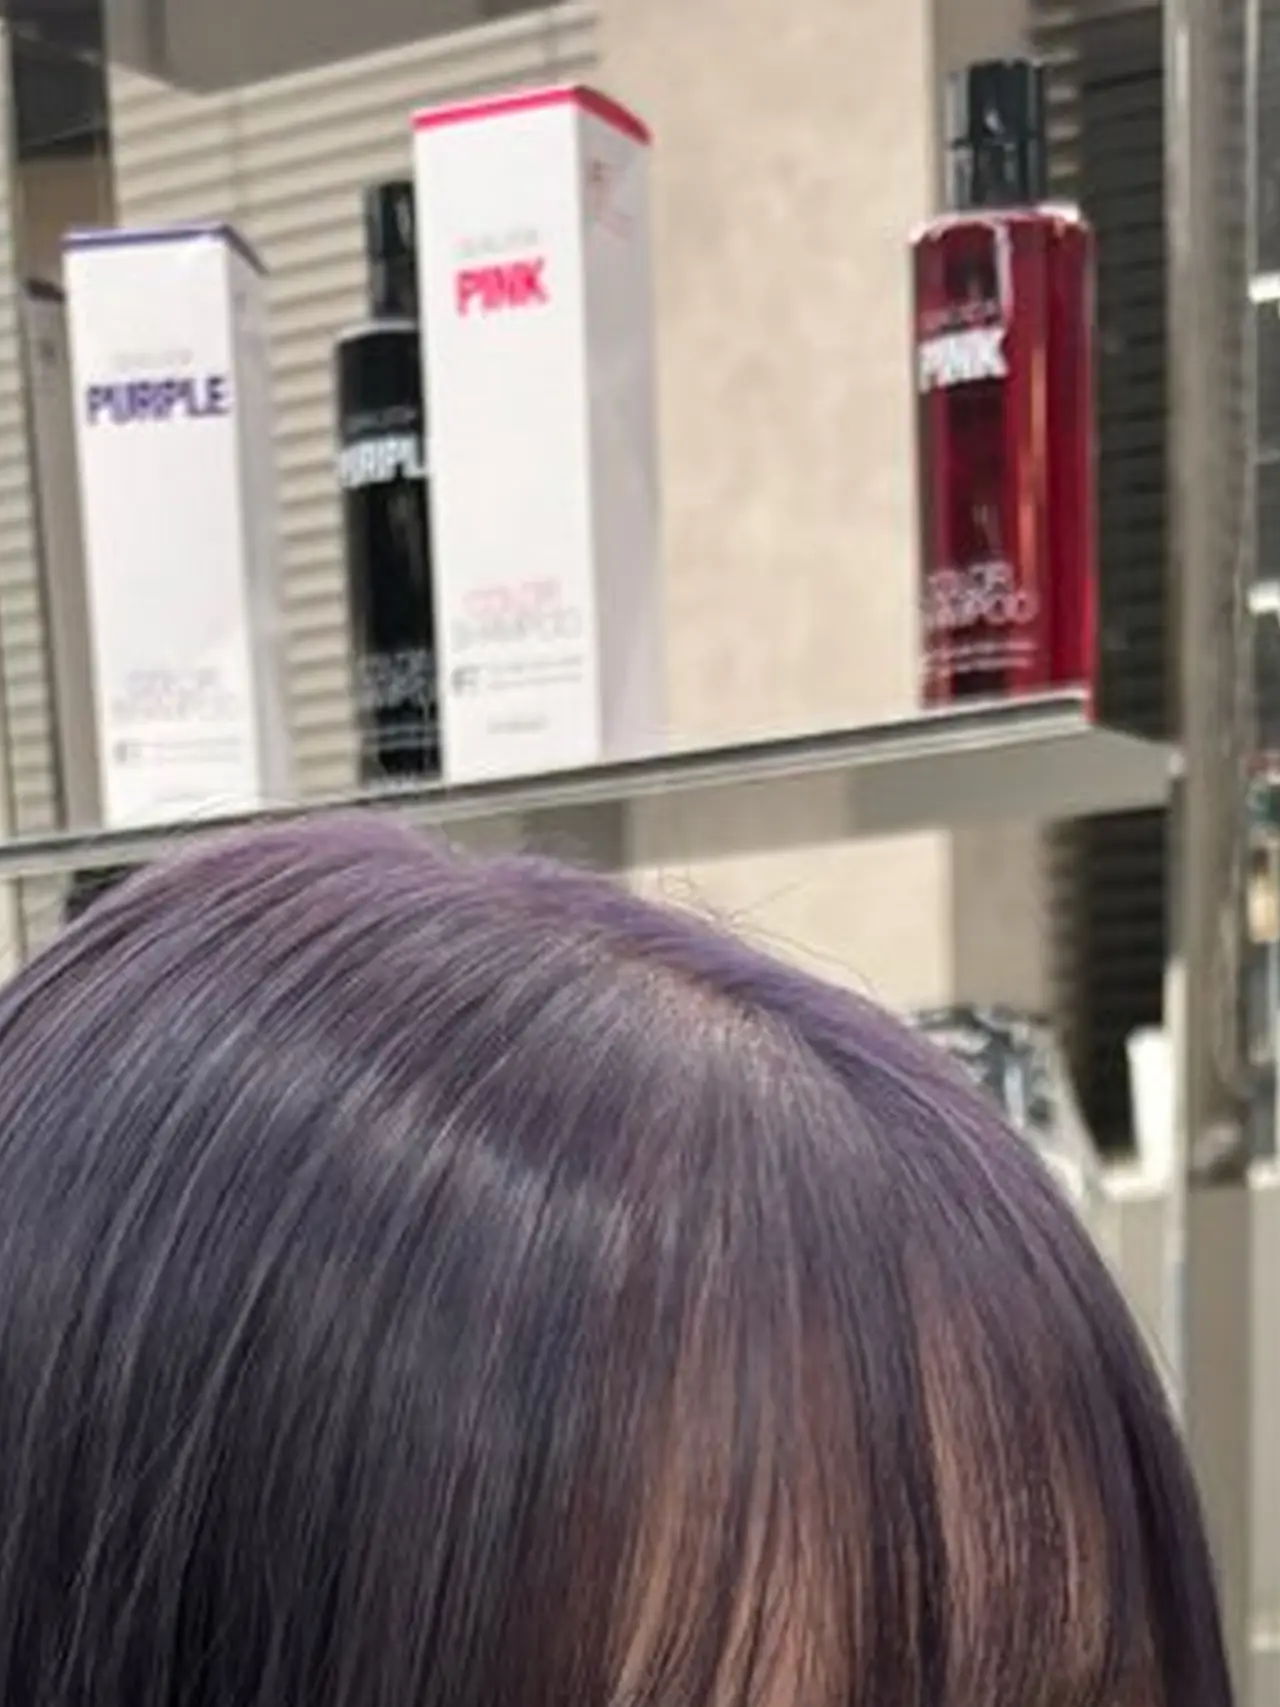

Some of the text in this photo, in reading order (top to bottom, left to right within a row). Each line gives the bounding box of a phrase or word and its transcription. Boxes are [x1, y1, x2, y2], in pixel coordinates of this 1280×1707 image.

[456, 256, 550, 317] PINK
[918, 328, 1009, 393] PINK
[86, 375, 230, 424] PURPLE
